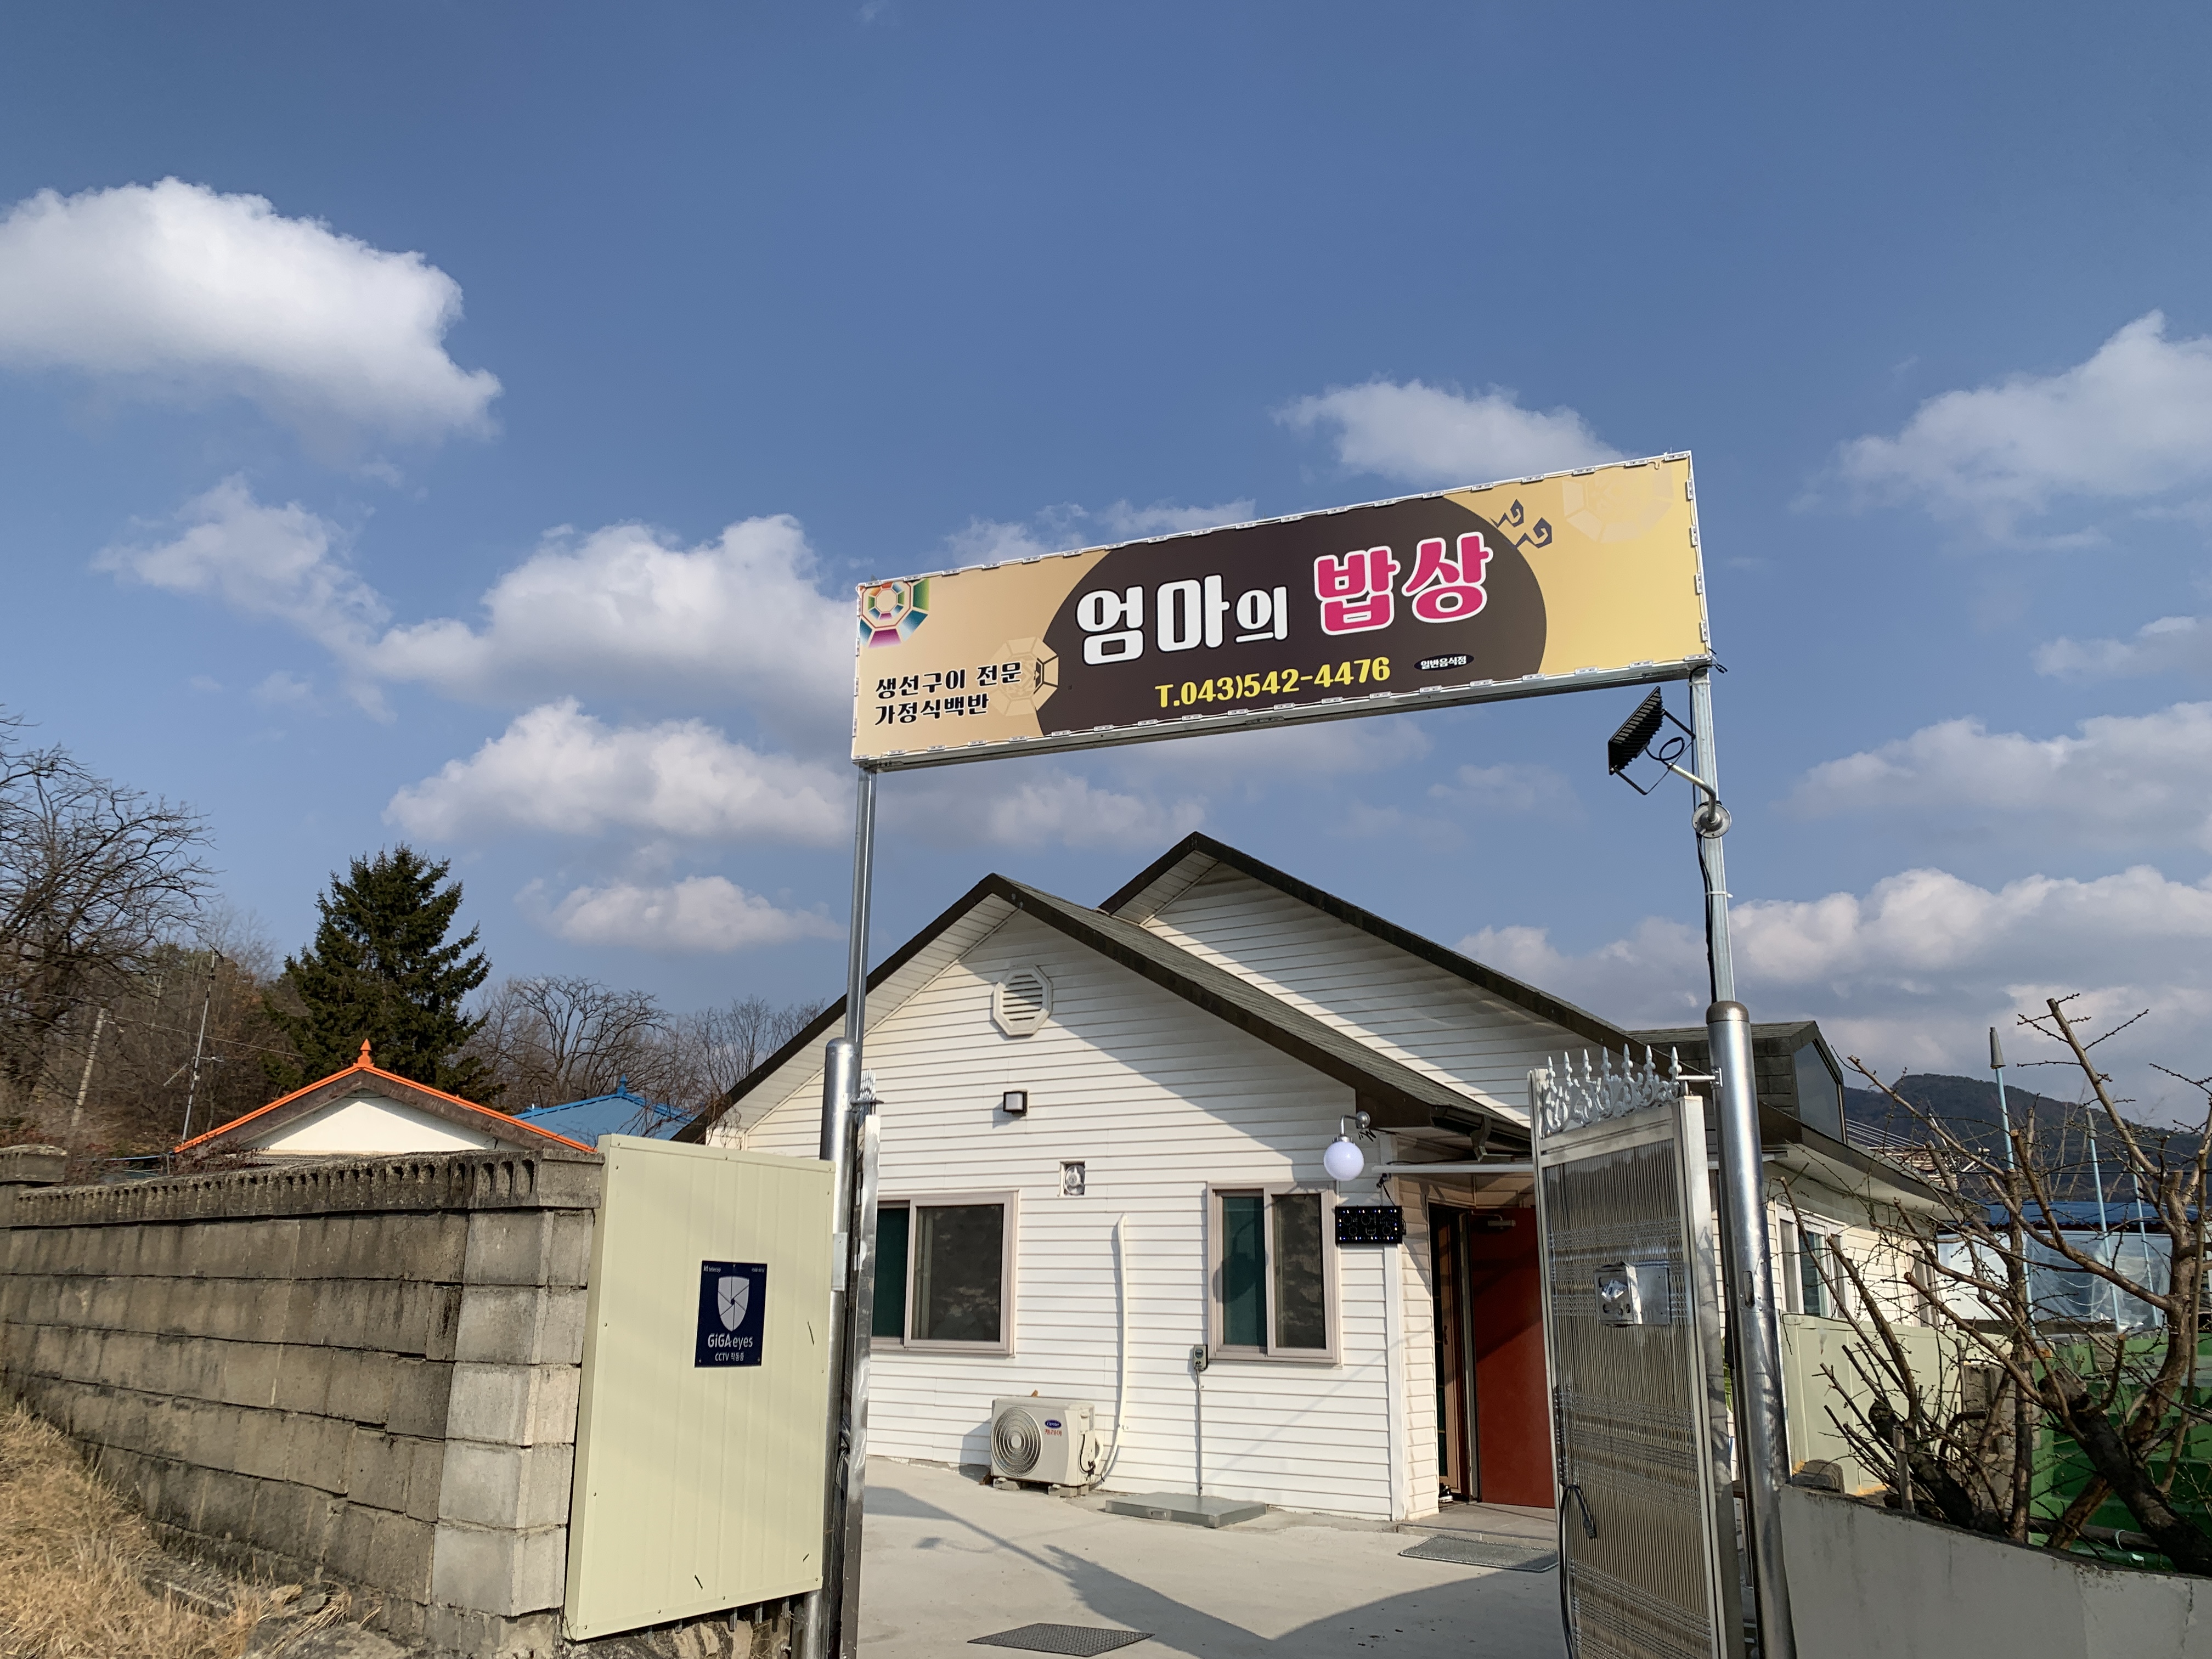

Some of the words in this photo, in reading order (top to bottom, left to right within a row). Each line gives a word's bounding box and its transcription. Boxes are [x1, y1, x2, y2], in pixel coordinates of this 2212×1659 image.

[1076, 574, 1289, 665] 엄마의
[1313, 531, 1494, 636] 밥상
[875, 669, 967, 699] 생선구이
[977, 661, 1022, 687] 전문
[1420, 655, 1467, 670] 일반음식점
[1155, 656, 1391, 708] T.043)542-4476
[874, 692, 990, 726] 가정식백반
[715, 1351, 730, 1362] CCTV
[730, 1351, 744, 1362] 작동중
